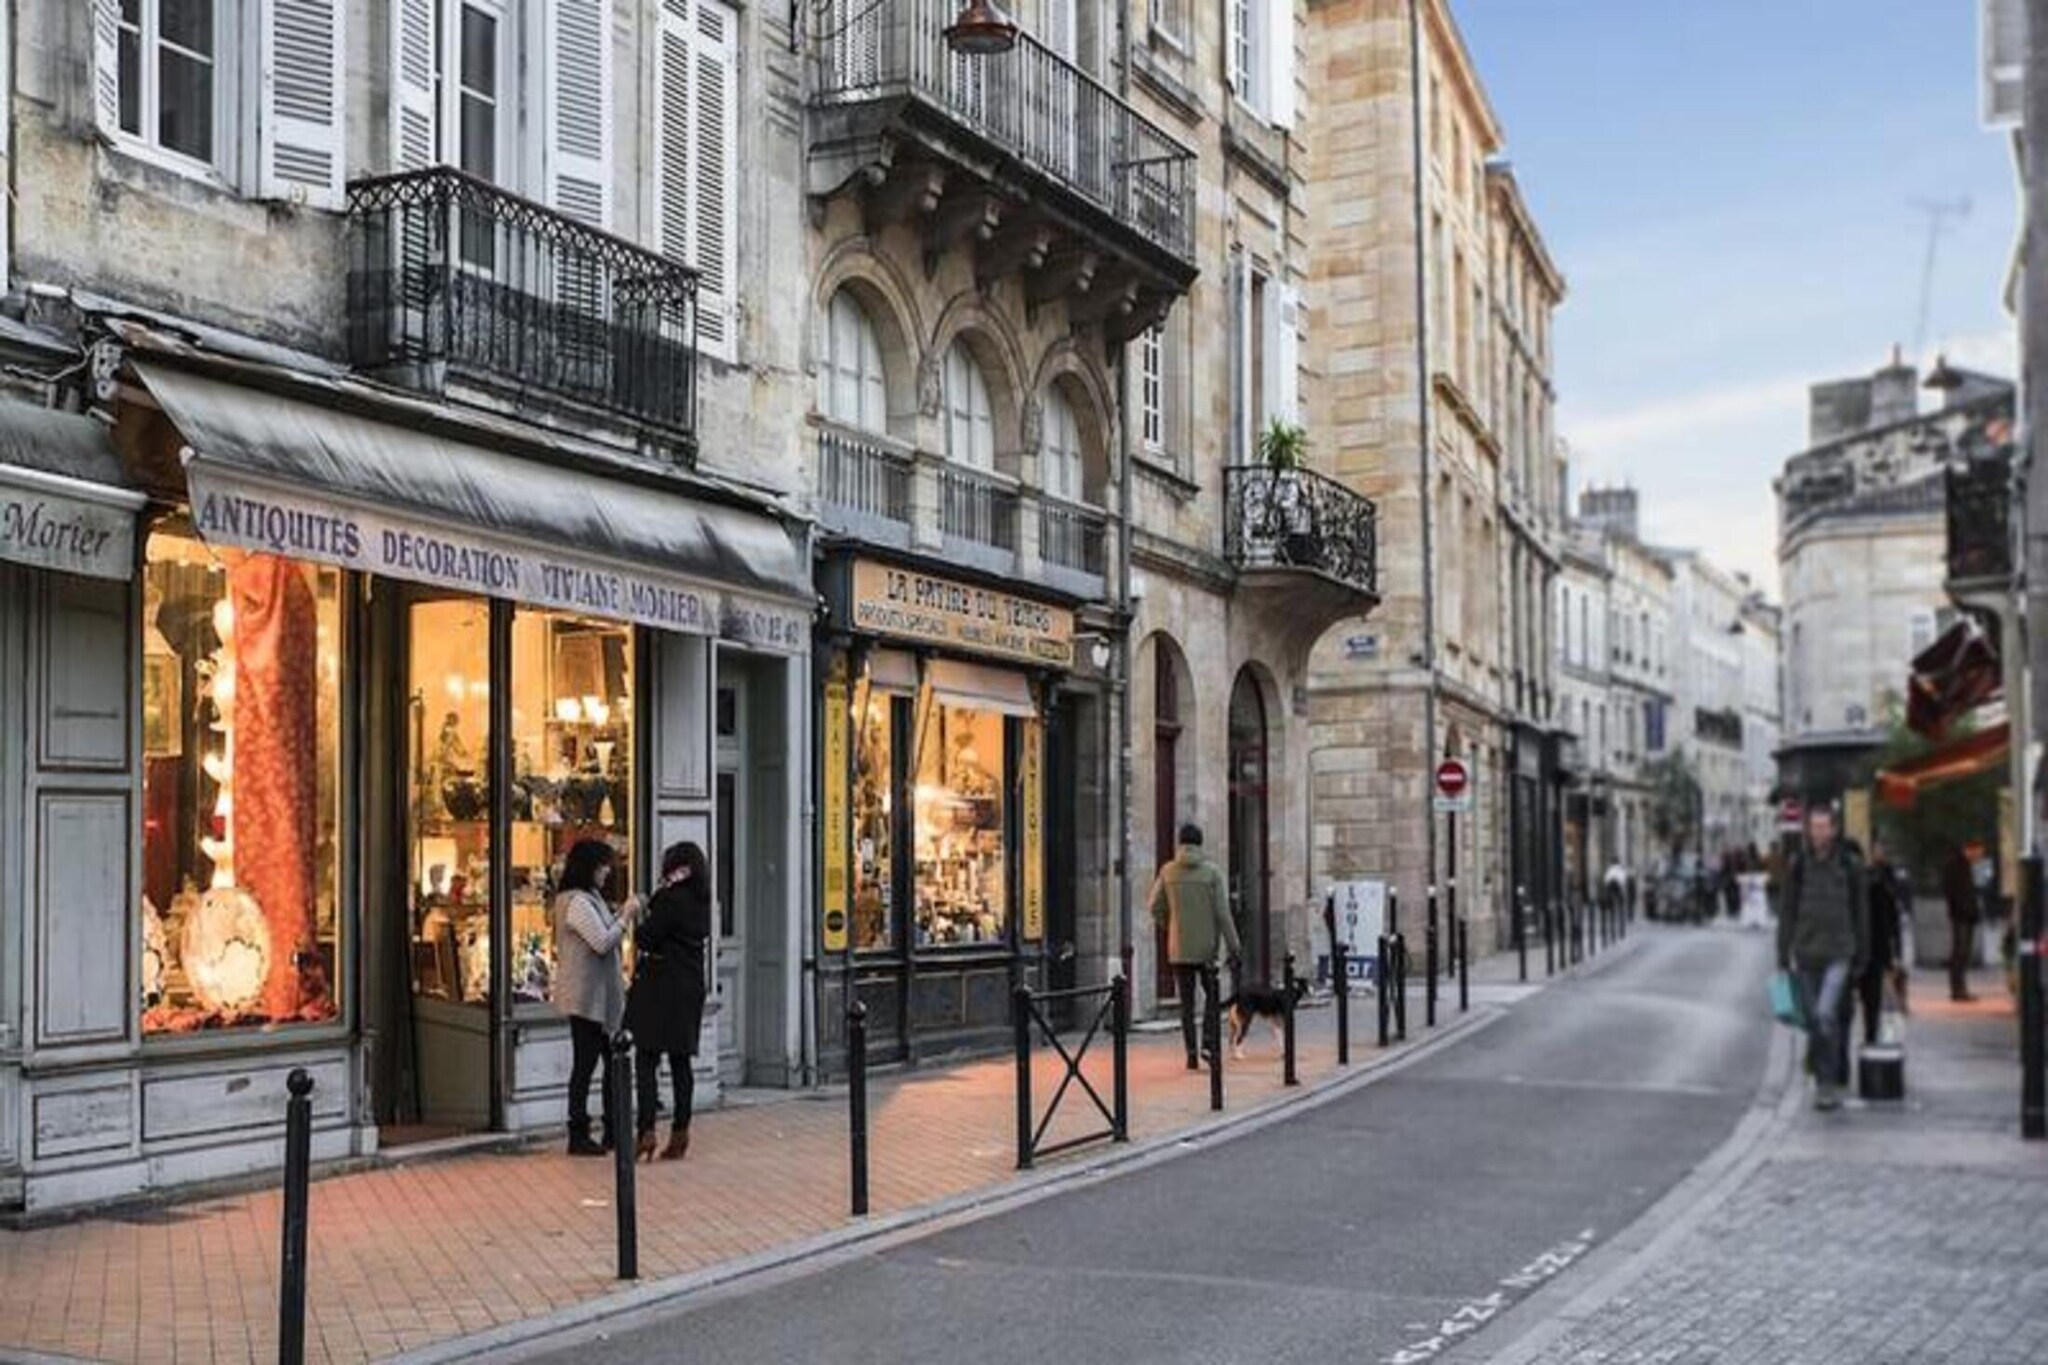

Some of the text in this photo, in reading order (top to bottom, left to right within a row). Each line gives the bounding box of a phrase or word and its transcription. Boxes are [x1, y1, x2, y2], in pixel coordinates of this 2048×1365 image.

[4, 502, 111, 558] Morier
[538, 563, 619, 610] VIVIANE
[630, 581, 700, 625] MORIER
[887, 570, 908, 604] LA
